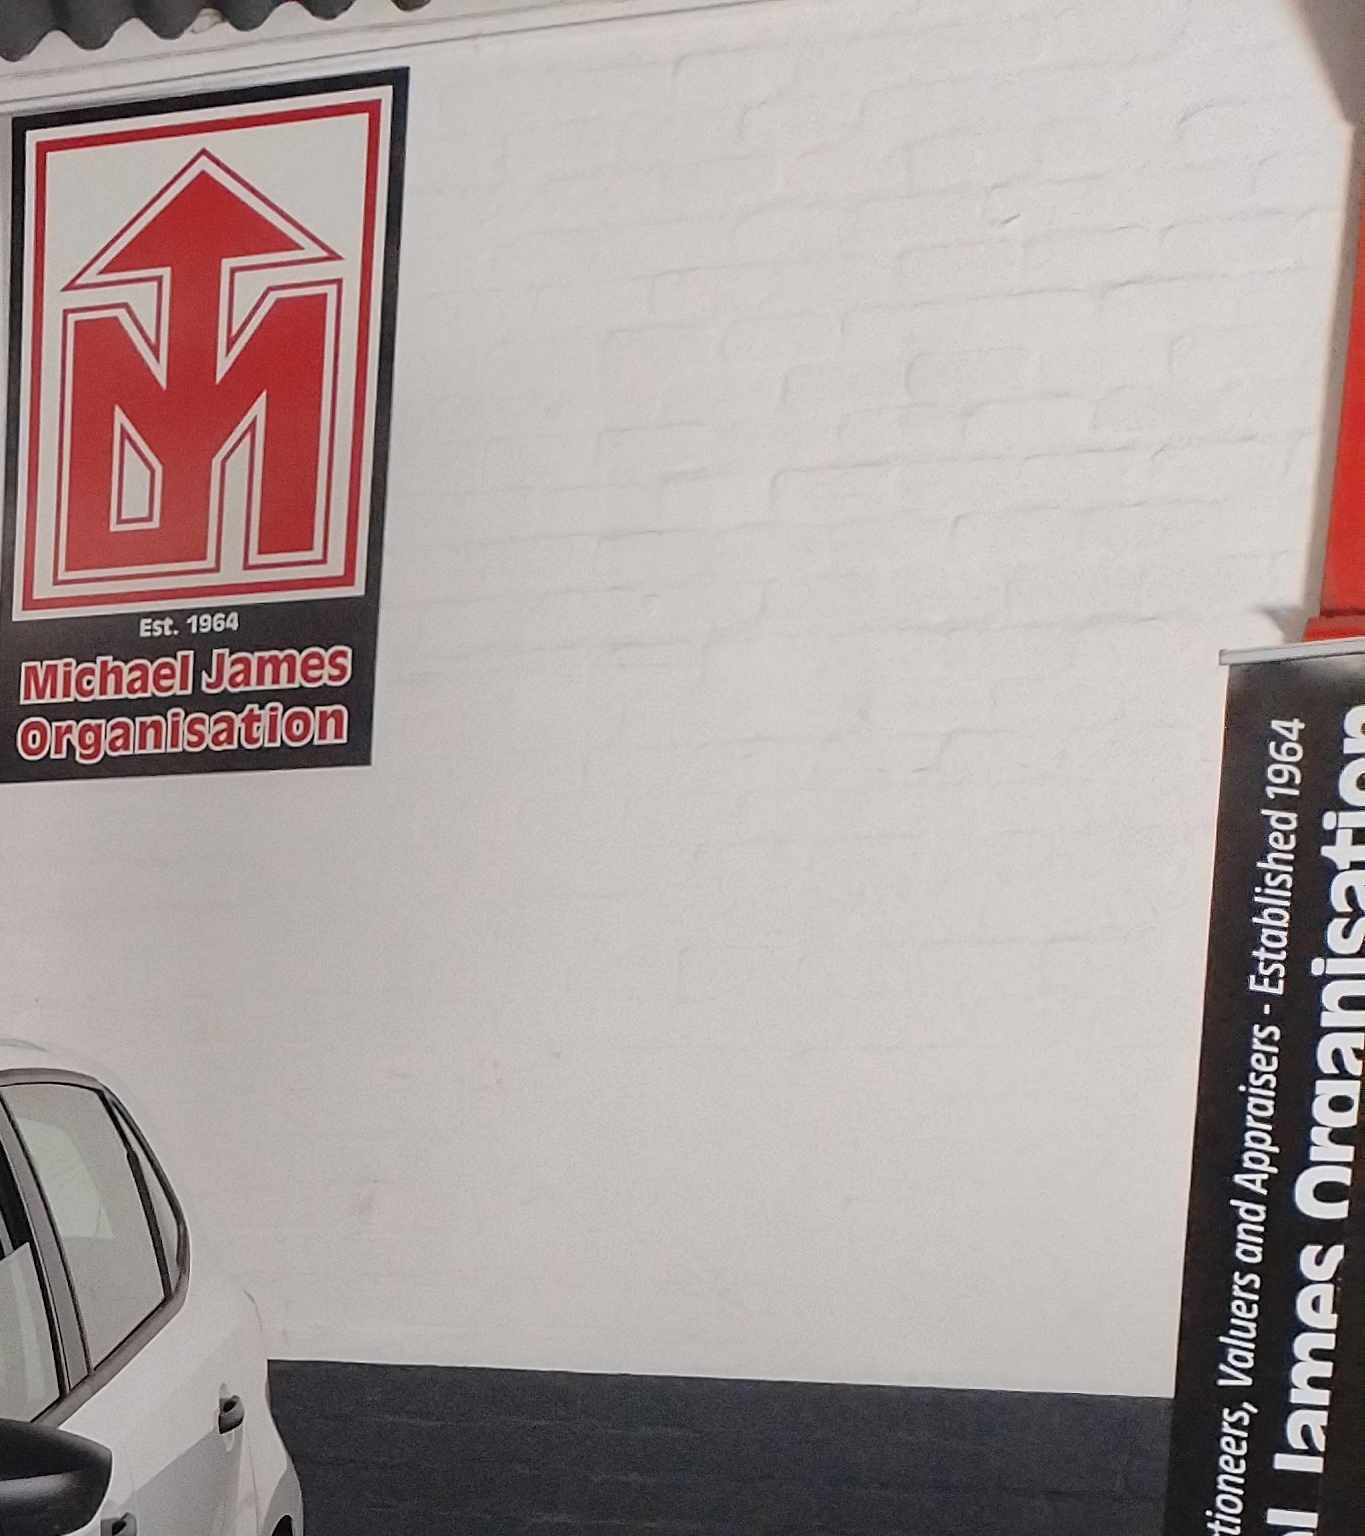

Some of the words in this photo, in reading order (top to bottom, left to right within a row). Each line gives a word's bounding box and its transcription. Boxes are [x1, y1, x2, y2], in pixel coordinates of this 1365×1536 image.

[139, 616, 178, 637] Est.
[186, 612, 240, 635] 1964
[19, 650, 195, 705] Michael
[201, 645, 353, 695] James
[17, 702, 349, 765] Organisation
[1265, 718, 1306, 799] 1964
[1248, 808, 1299, 996] Established
[1233, 1023, 1281, 1196] Appraisers
[1229, 1198, 1267, 1264] and
[1216, 1271, 1261, 1386] Valuers
